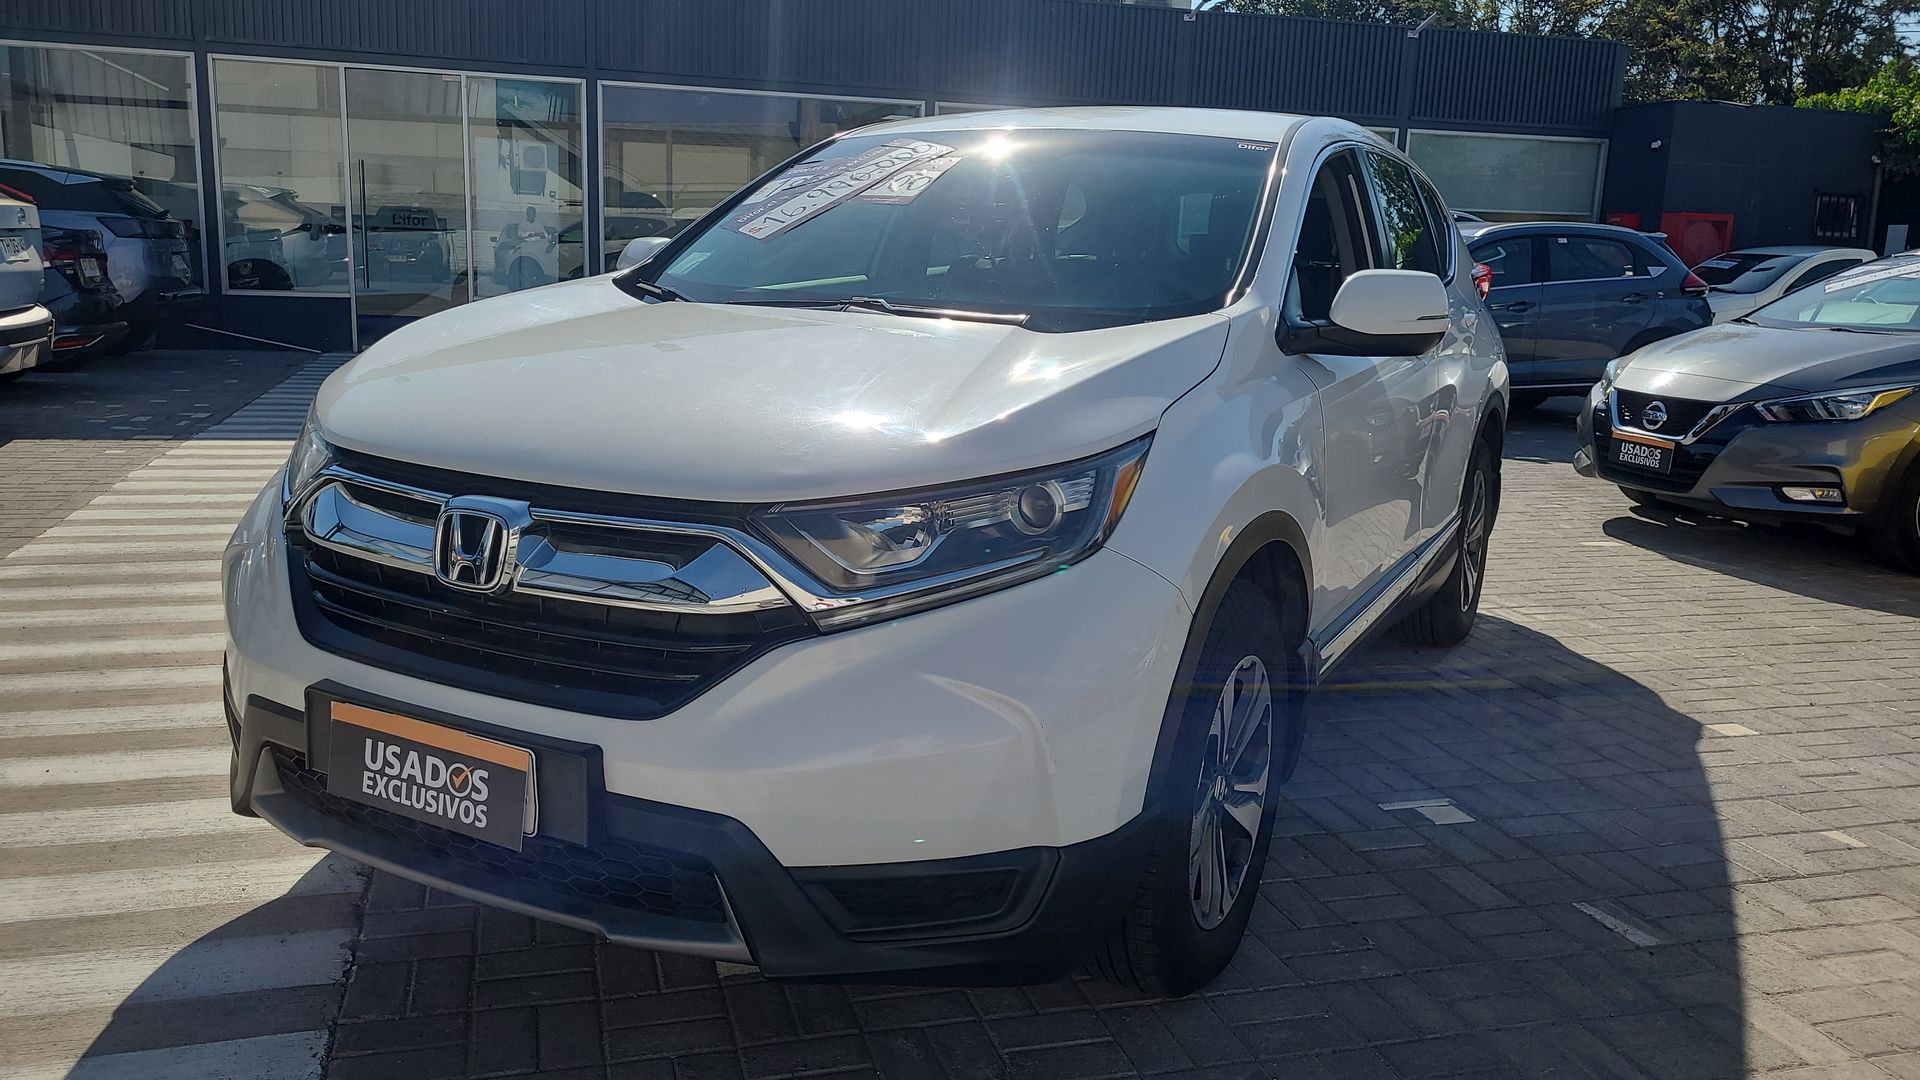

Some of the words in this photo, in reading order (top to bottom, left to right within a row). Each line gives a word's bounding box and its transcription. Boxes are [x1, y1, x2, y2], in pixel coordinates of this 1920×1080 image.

[1619, 452, 1660, 468] EXCLUSIVOS
[1622, 442, 1661, 460] USADOS
[365, 738, 489, 801] USADOS
[362, 771, 488, 829] EXCLUSIVOS
